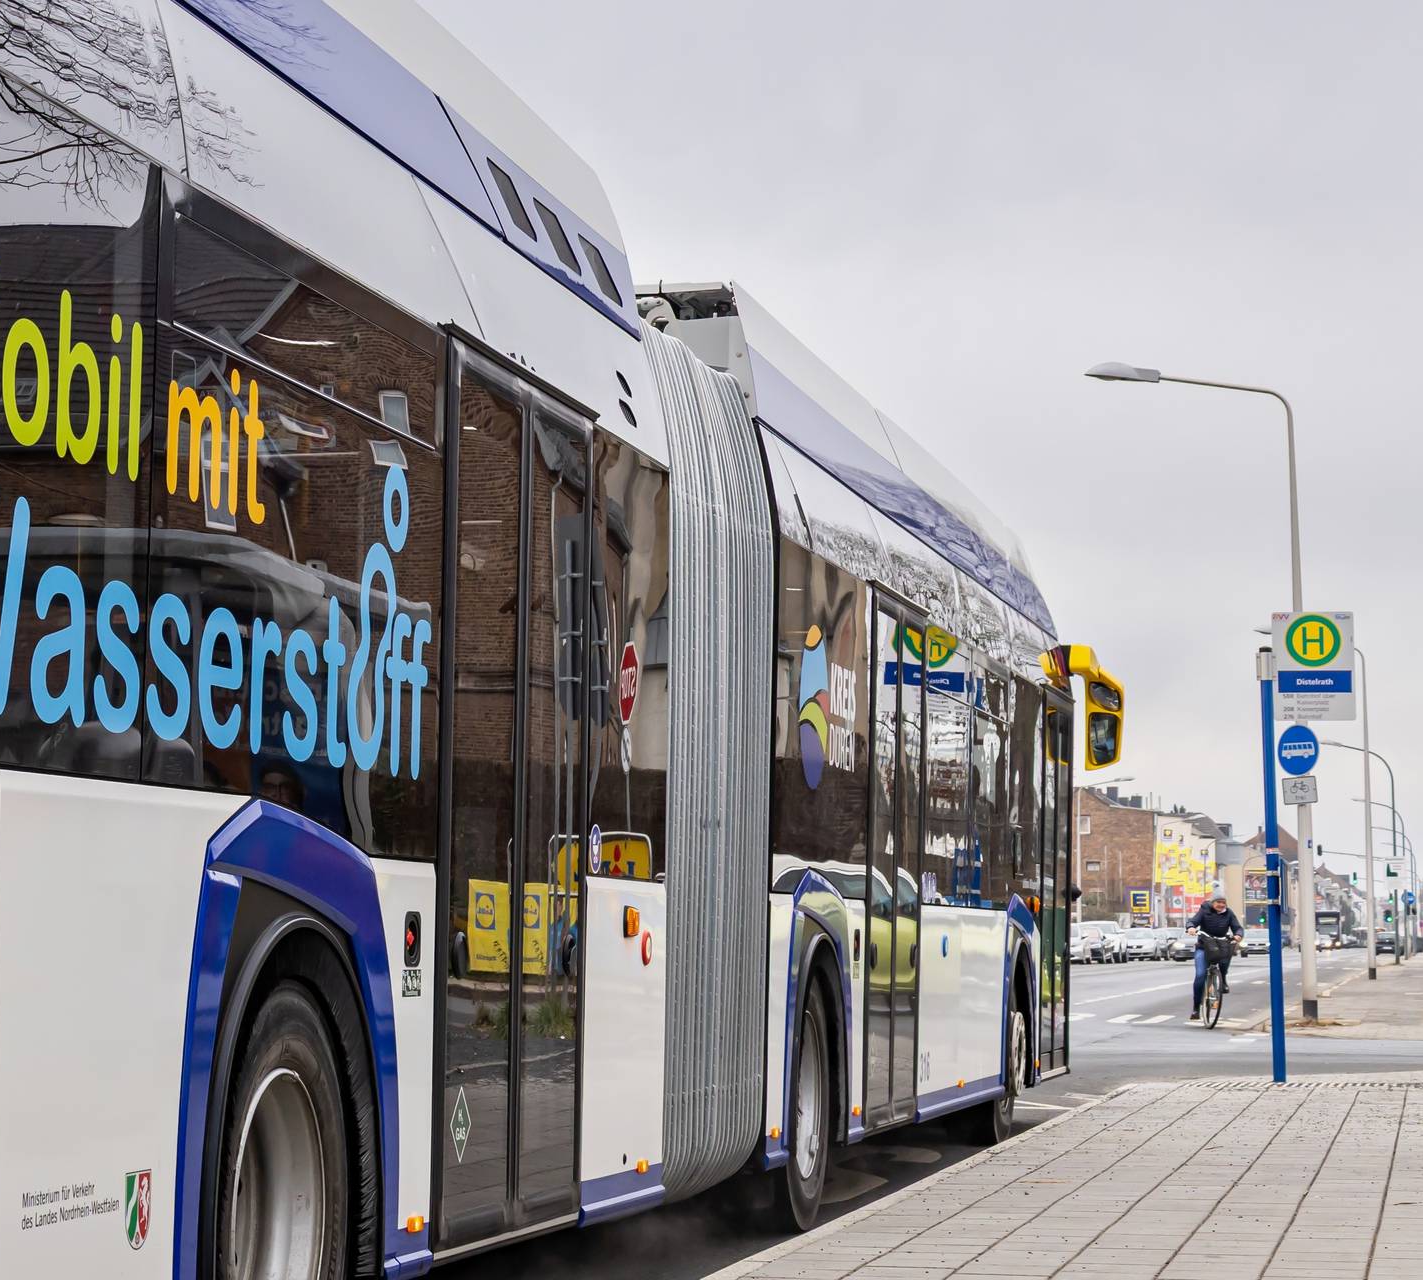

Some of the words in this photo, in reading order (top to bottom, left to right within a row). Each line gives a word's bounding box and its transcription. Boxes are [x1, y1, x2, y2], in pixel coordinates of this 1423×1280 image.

[166, 368, 266, 525] mit
[830, 662, 856, 722] KREIS
[1296, 678, 1334, 686] Distelrath
[456, 1127, 465, 1141] GAS
[22, 1191, 60, 1208] Ministerium
[61, 1187, 71, 1200] für
[72, 1183, 95, 1197] Verkehr
[21, 1214, 33, 1230] des
[35, 1210, 58, 1227] Landes
[59, 1198, 120, 1222] Nordrhein-Westfalen
